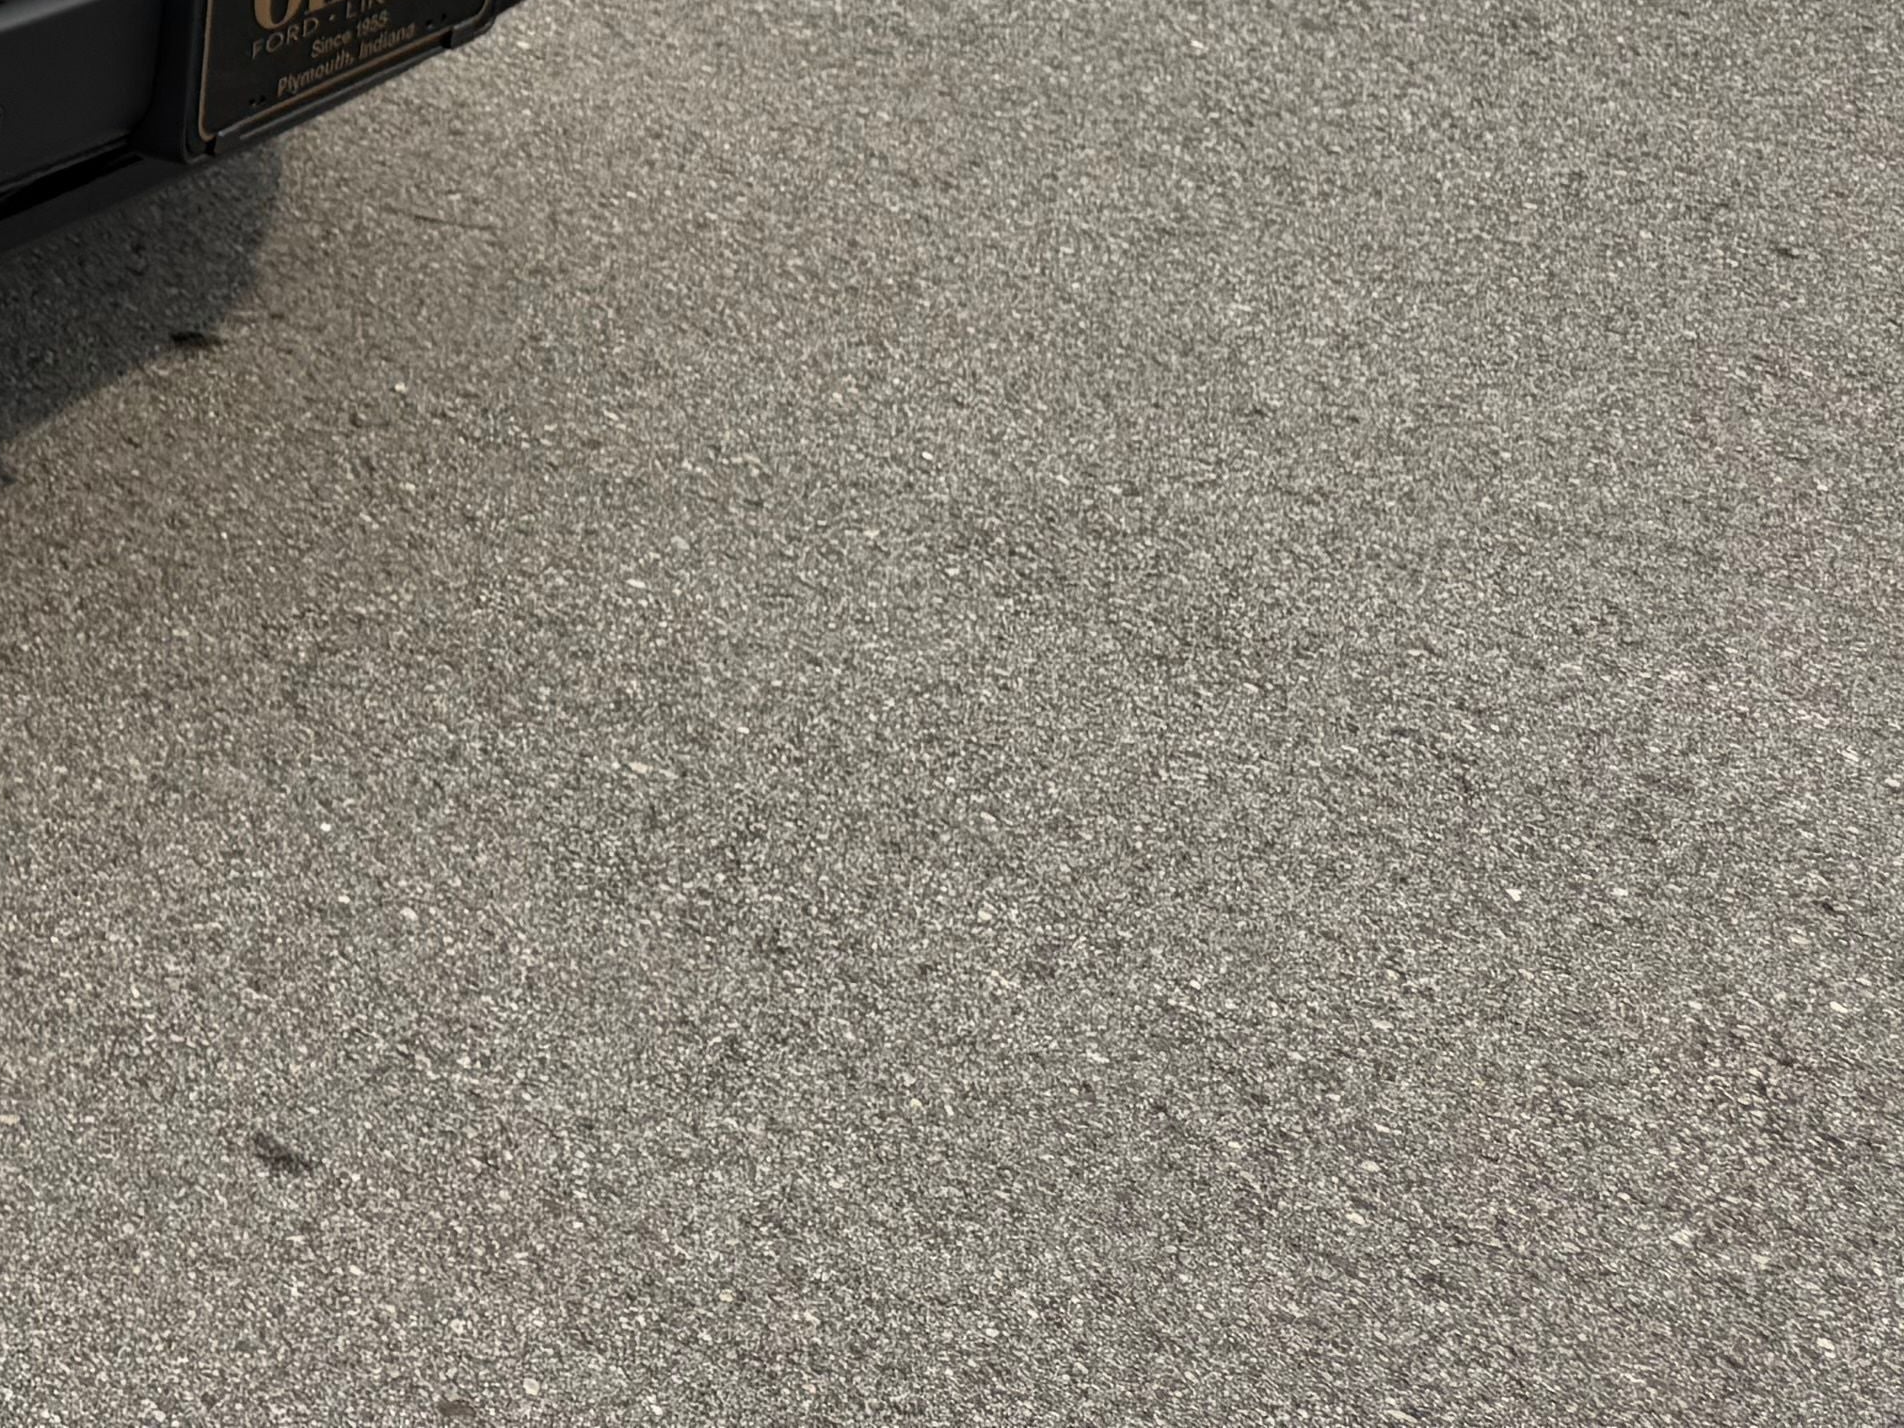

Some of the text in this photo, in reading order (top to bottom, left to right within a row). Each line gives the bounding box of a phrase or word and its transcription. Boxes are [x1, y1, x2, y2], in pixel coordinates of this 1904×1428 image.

[252, 17, 320, 59] FORD
[311, 30, 352, 59] Since
[359, 22, 417, 59] Indiana
